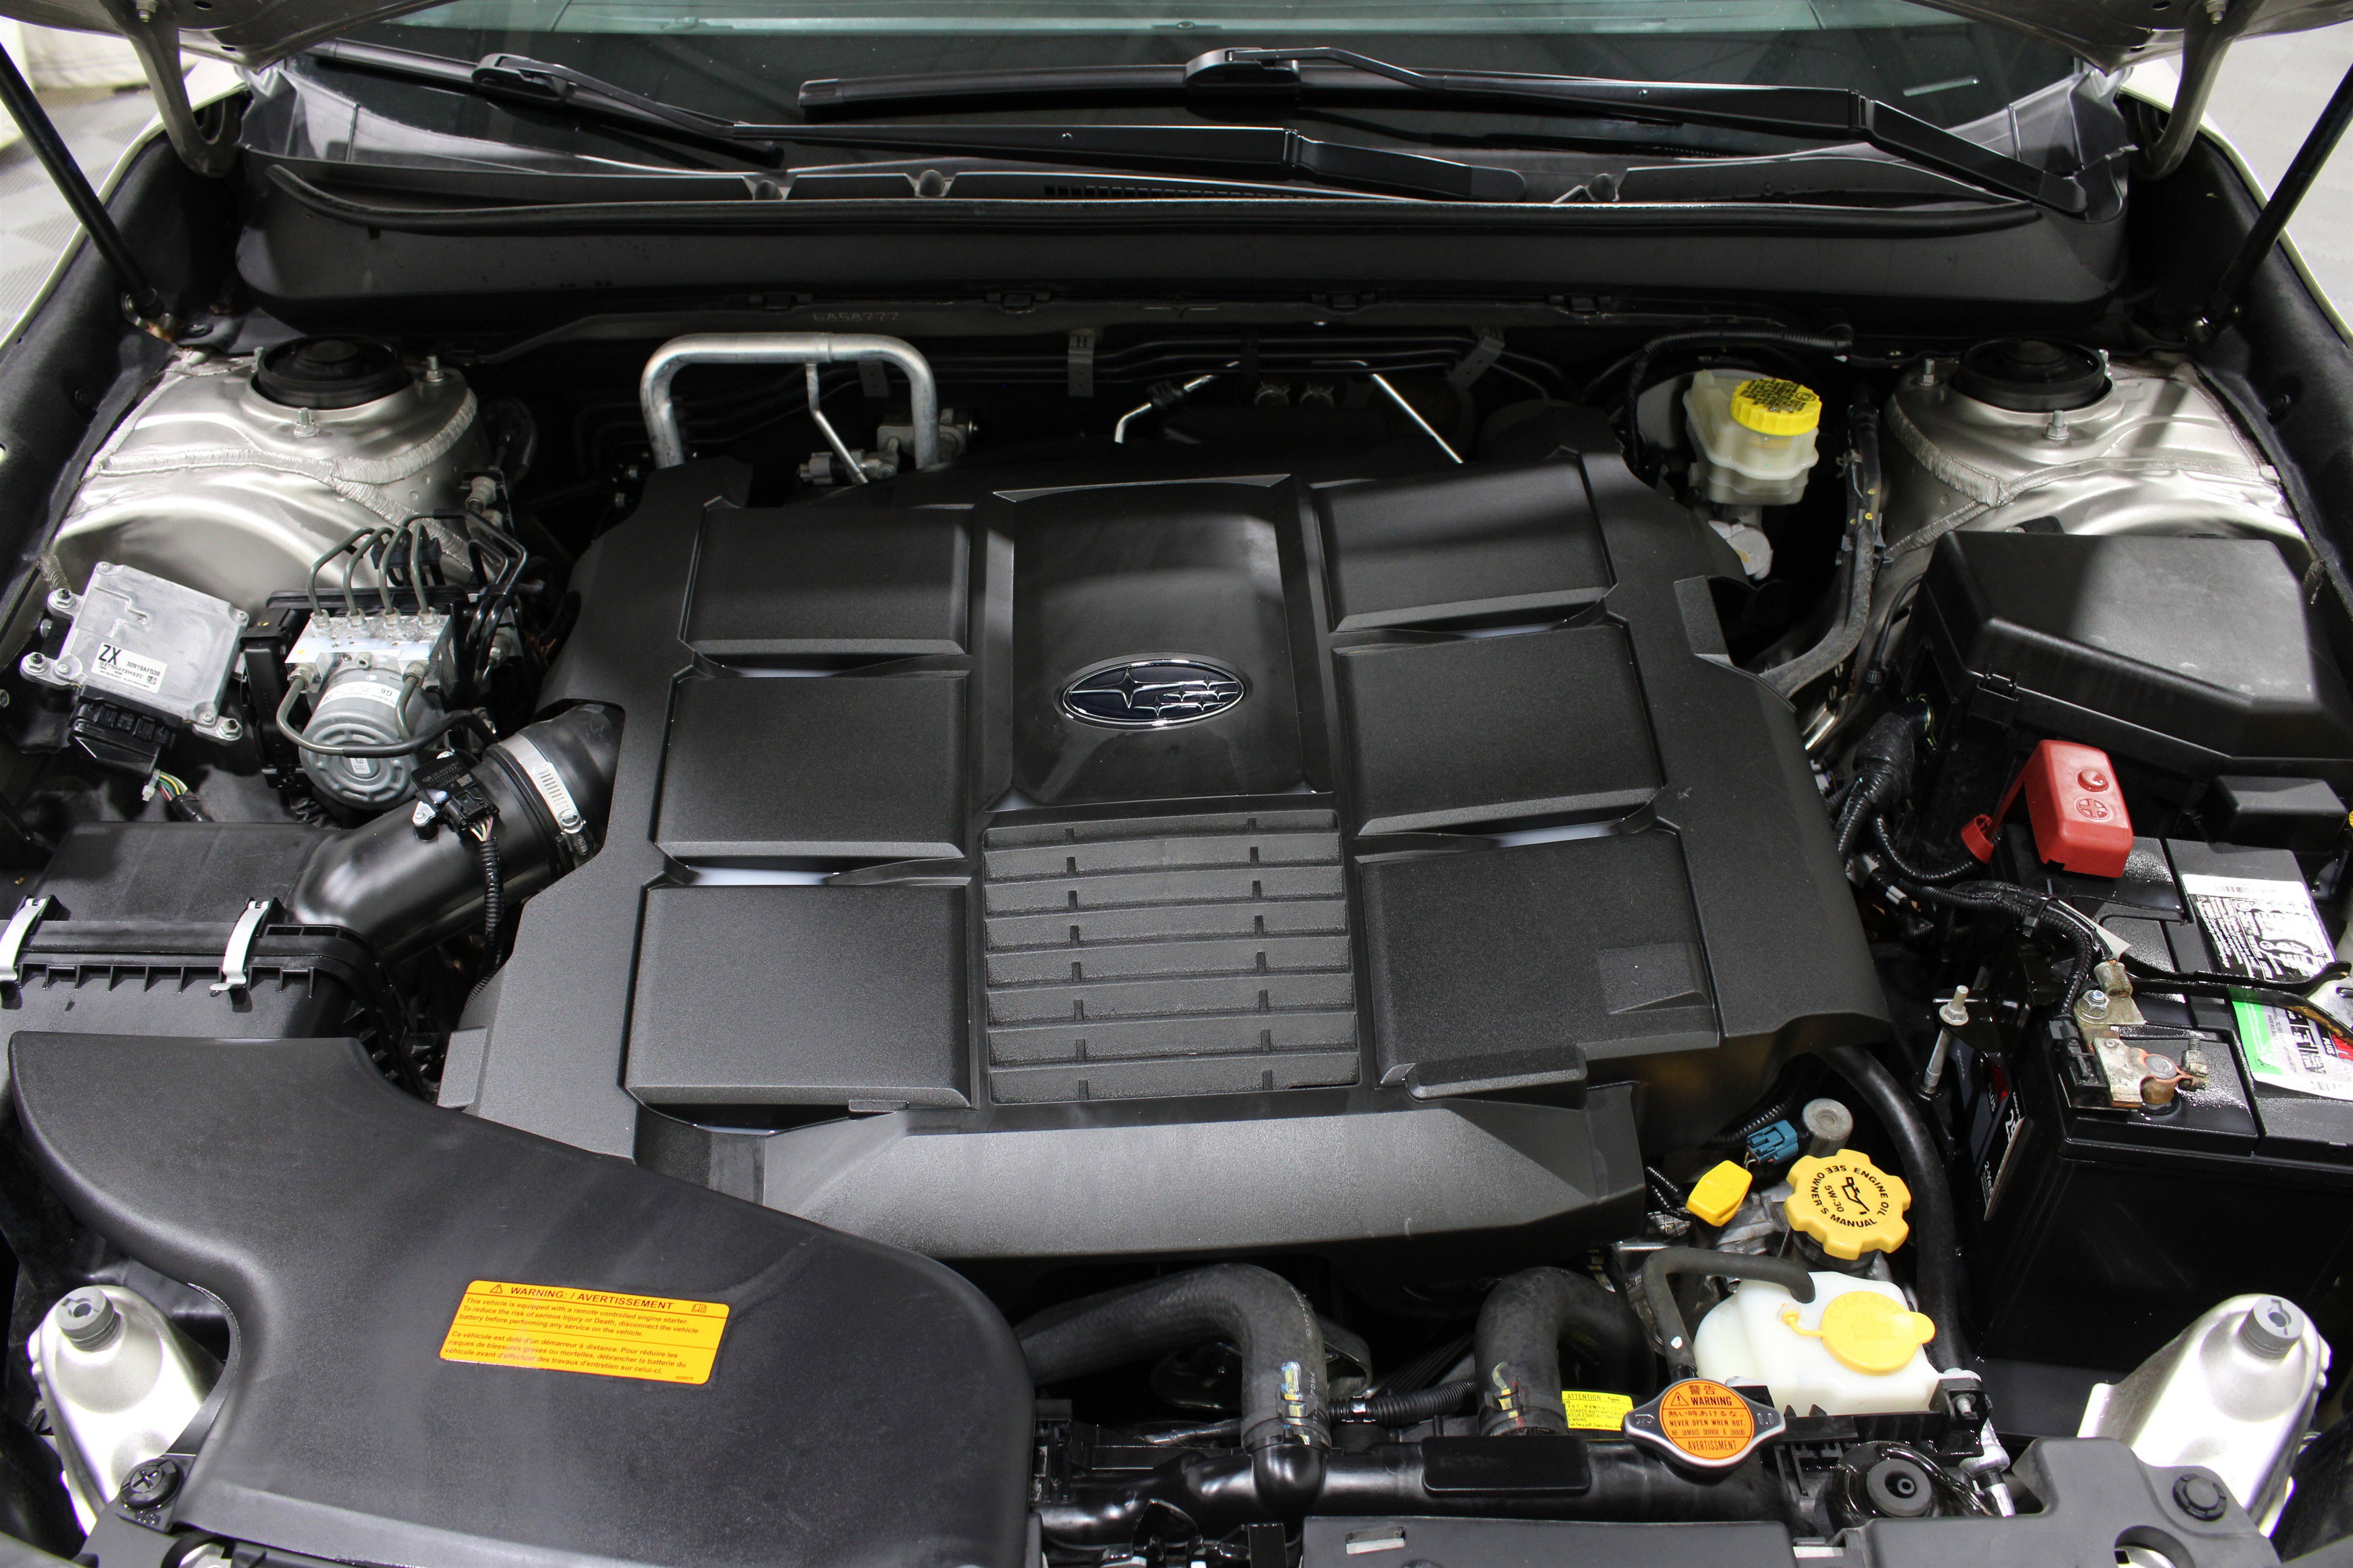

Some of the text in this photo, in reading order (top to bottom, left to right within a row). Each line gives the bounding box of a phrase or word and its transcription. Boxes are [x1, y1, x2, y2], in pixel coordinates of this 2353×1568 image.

[98, 644, 122, 665] ZX
[2322, 1037, 2335, 1055] PLUS
[1811, 1165, 1877, 1227] SEE OWNER'S MANUAL
[1824, 1185, 1845, 1212] 5W-30
[1853, 1167, 1889, 1215] ENGINE OIL
[510, 1287, 568, 1299] WARNING:
[576, 1293, 674, 1309] AVERTISSEMENT
[1828, 1293, 1904, 1319] COOLANT
[516, 1302, 550, 1311] equipped
[599, 1311, 637, 1319] controlled
[458, 1314, 484, 1322] battery
[509, 1318, 548, 1327] performing
[593, 1318, 618, 1326] Death,
[618, 1320, 658, 1329] disconnect
[447, 1339, 475, 1347] risques
[486, 1342, 522, 1351] blessures
[647, 1358, 675, 1366] batterie
[1688, 1384, 1716, 1395] 警告
[1690, 1396, 1732, 1406] WARNING
[1688, 1440, 1737, 1451] AVERTISSMENT
